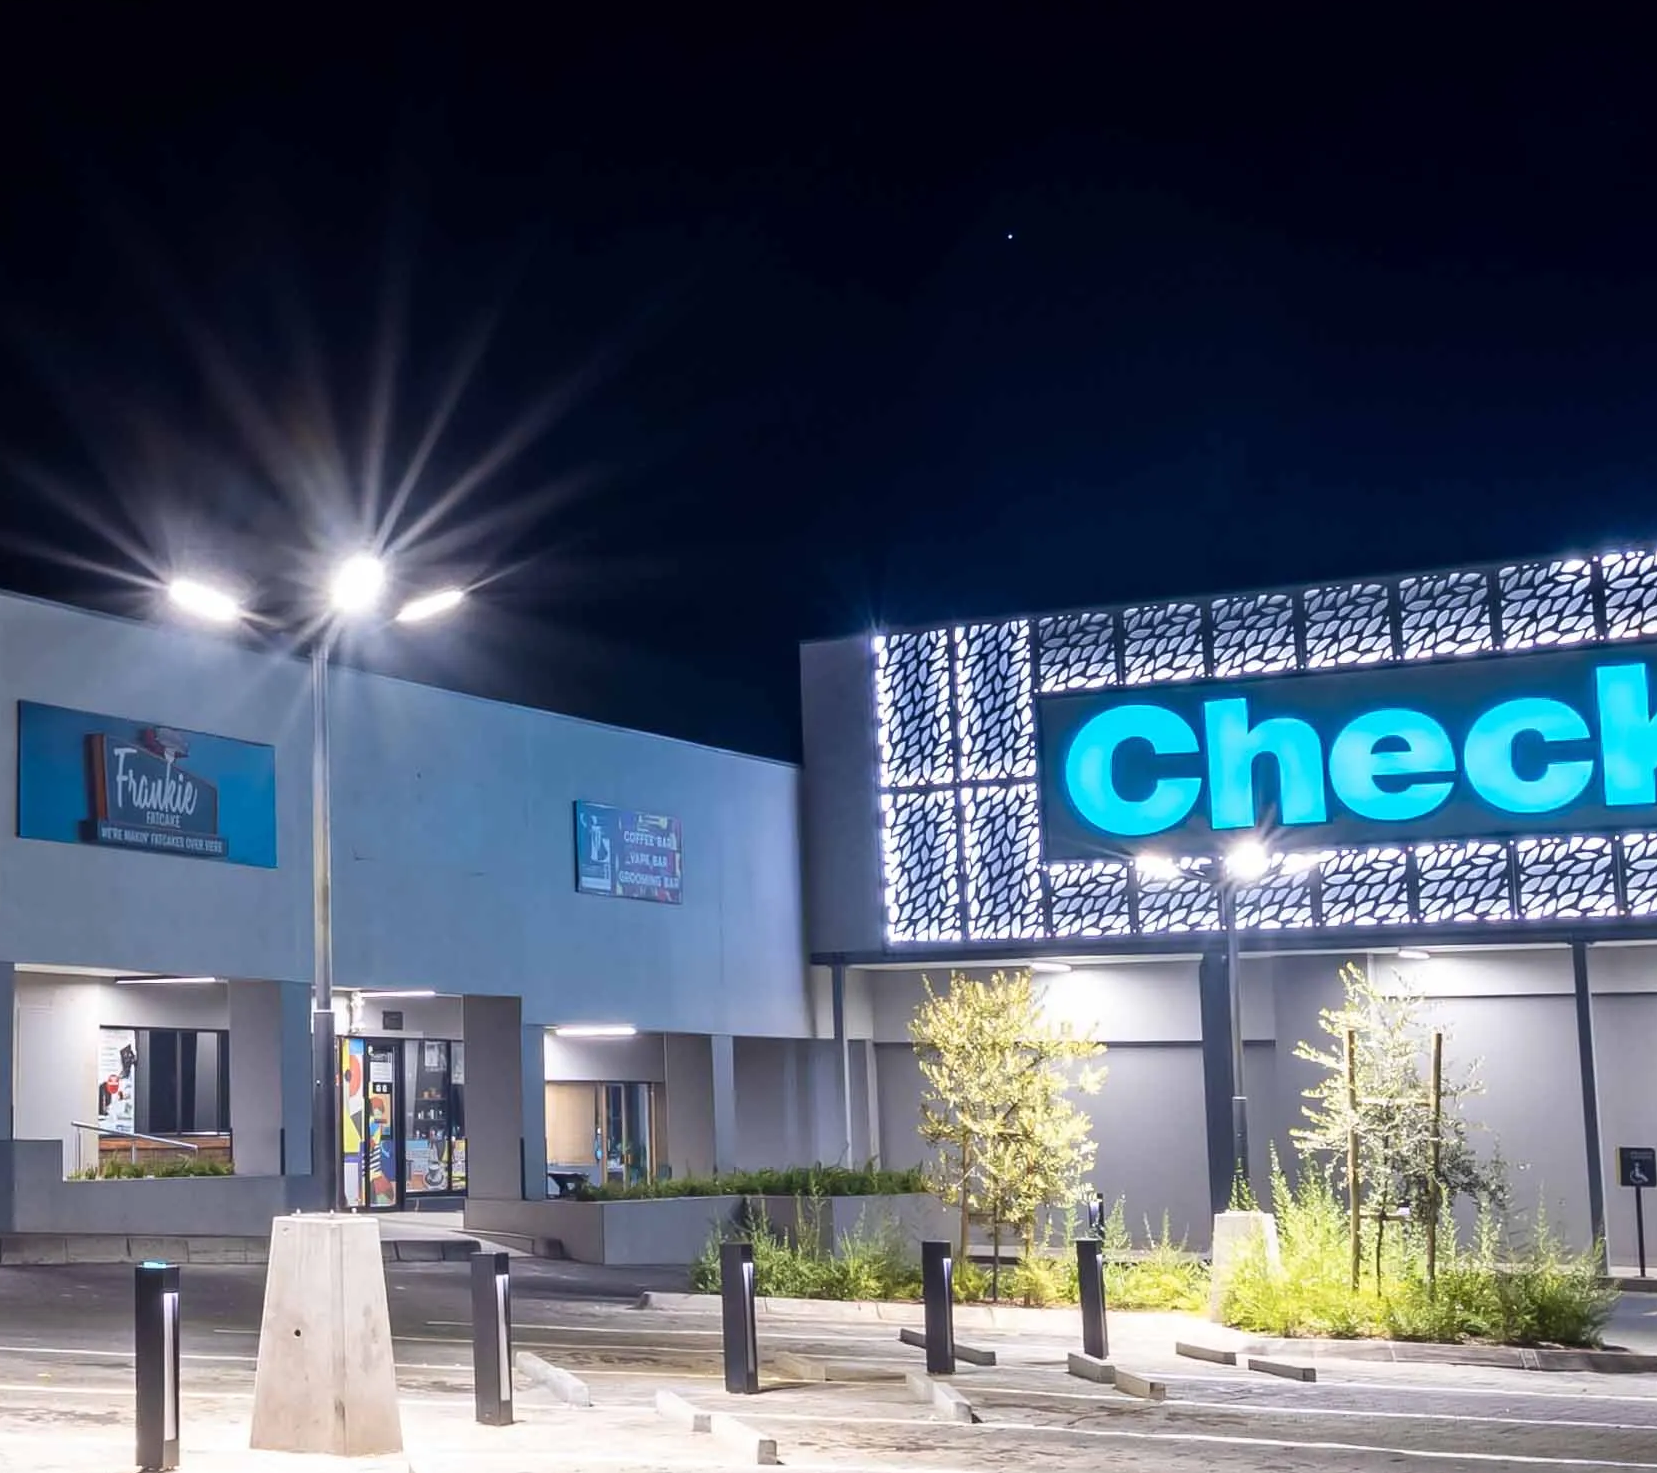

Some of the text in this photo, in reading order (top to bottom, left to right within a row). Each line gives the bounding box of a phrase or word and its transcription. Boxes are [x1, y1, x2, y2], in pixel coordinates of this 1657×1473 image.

[114, 747, 198, 816] Frankie
[146, 811, 181, 828] FATCAKE
[624, 830, 654, 846] COFFEE
[653, 854, 668, 867] BAR
